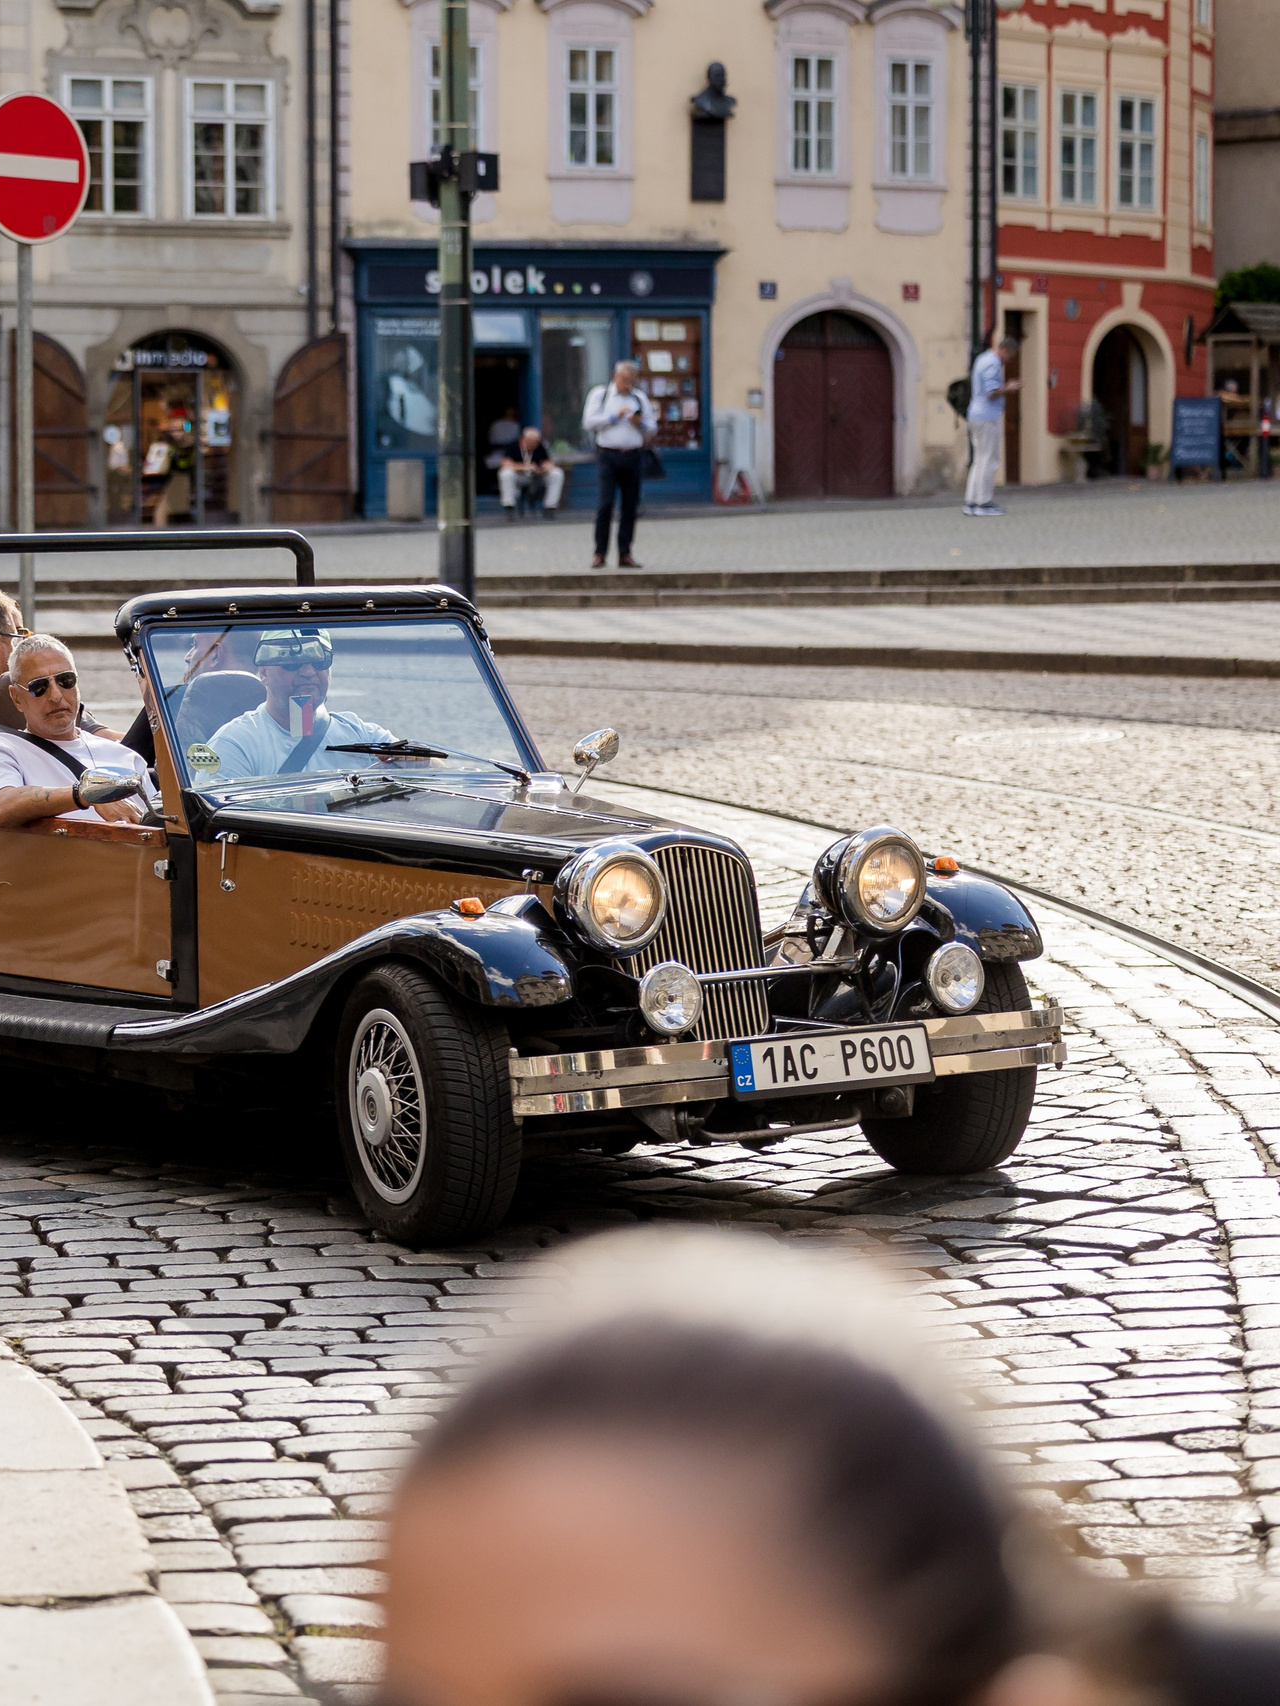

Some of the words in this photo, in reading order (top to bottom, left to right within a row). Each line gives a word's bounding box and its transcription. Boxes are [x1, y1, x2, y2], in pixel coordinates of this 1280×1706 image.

[762, 1043, 818, 1084] 1AC
[840, 1034, 915, 1076] P600
[737, 1074, 753, 1087] CZ
